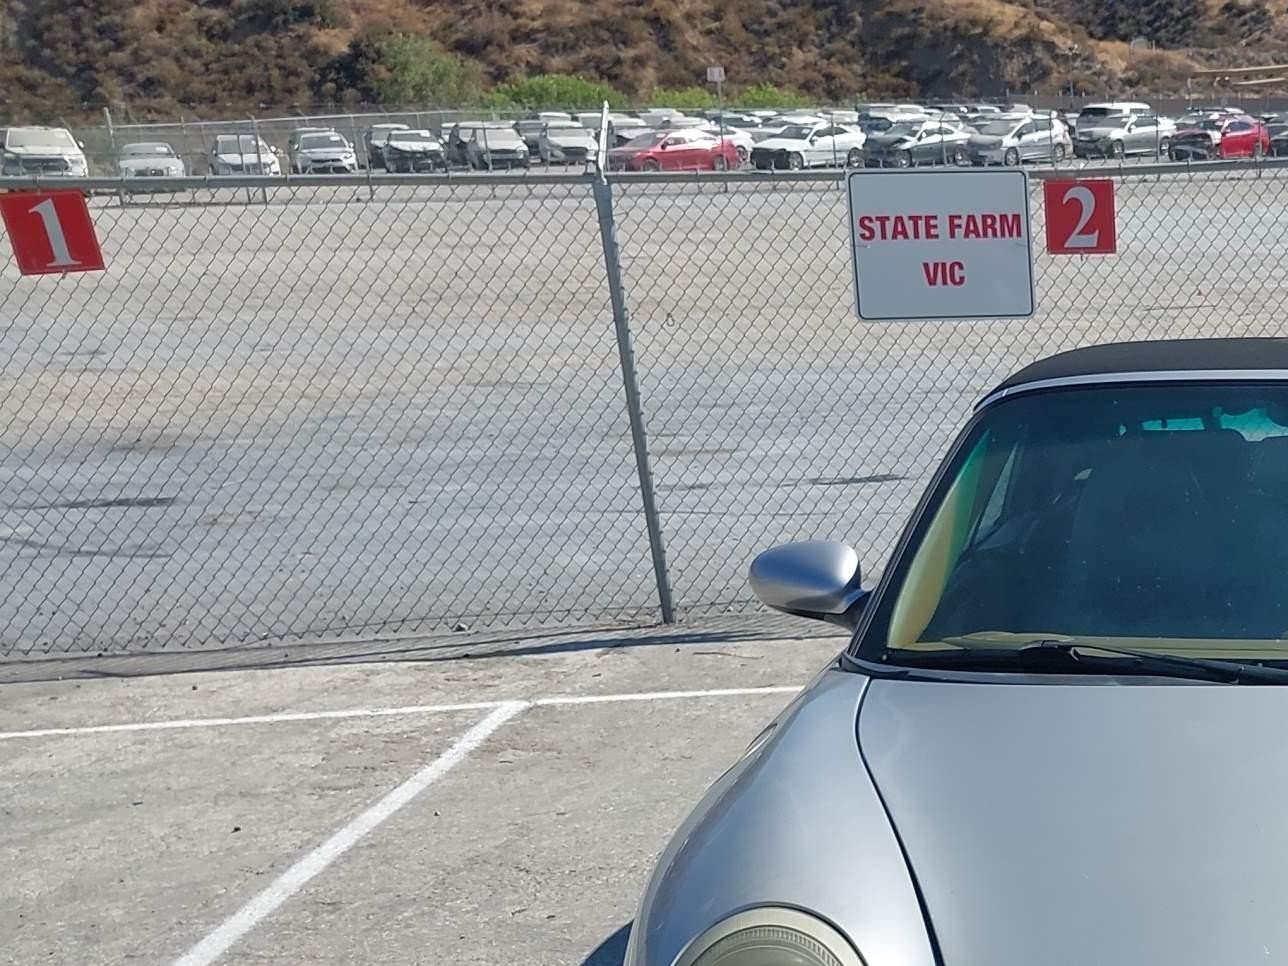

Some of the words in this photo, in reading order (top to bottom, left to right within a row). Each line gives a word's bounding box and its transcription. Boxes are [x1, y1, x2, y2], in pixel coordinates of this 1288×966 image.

[28, 198, 82, 266] 1
[858, 214, 939, 241] STATE
[948, 213, 1022, 239] FARM
[1062, 186, 1099, 248] 2
[923, 262, 966, 286] VIC
